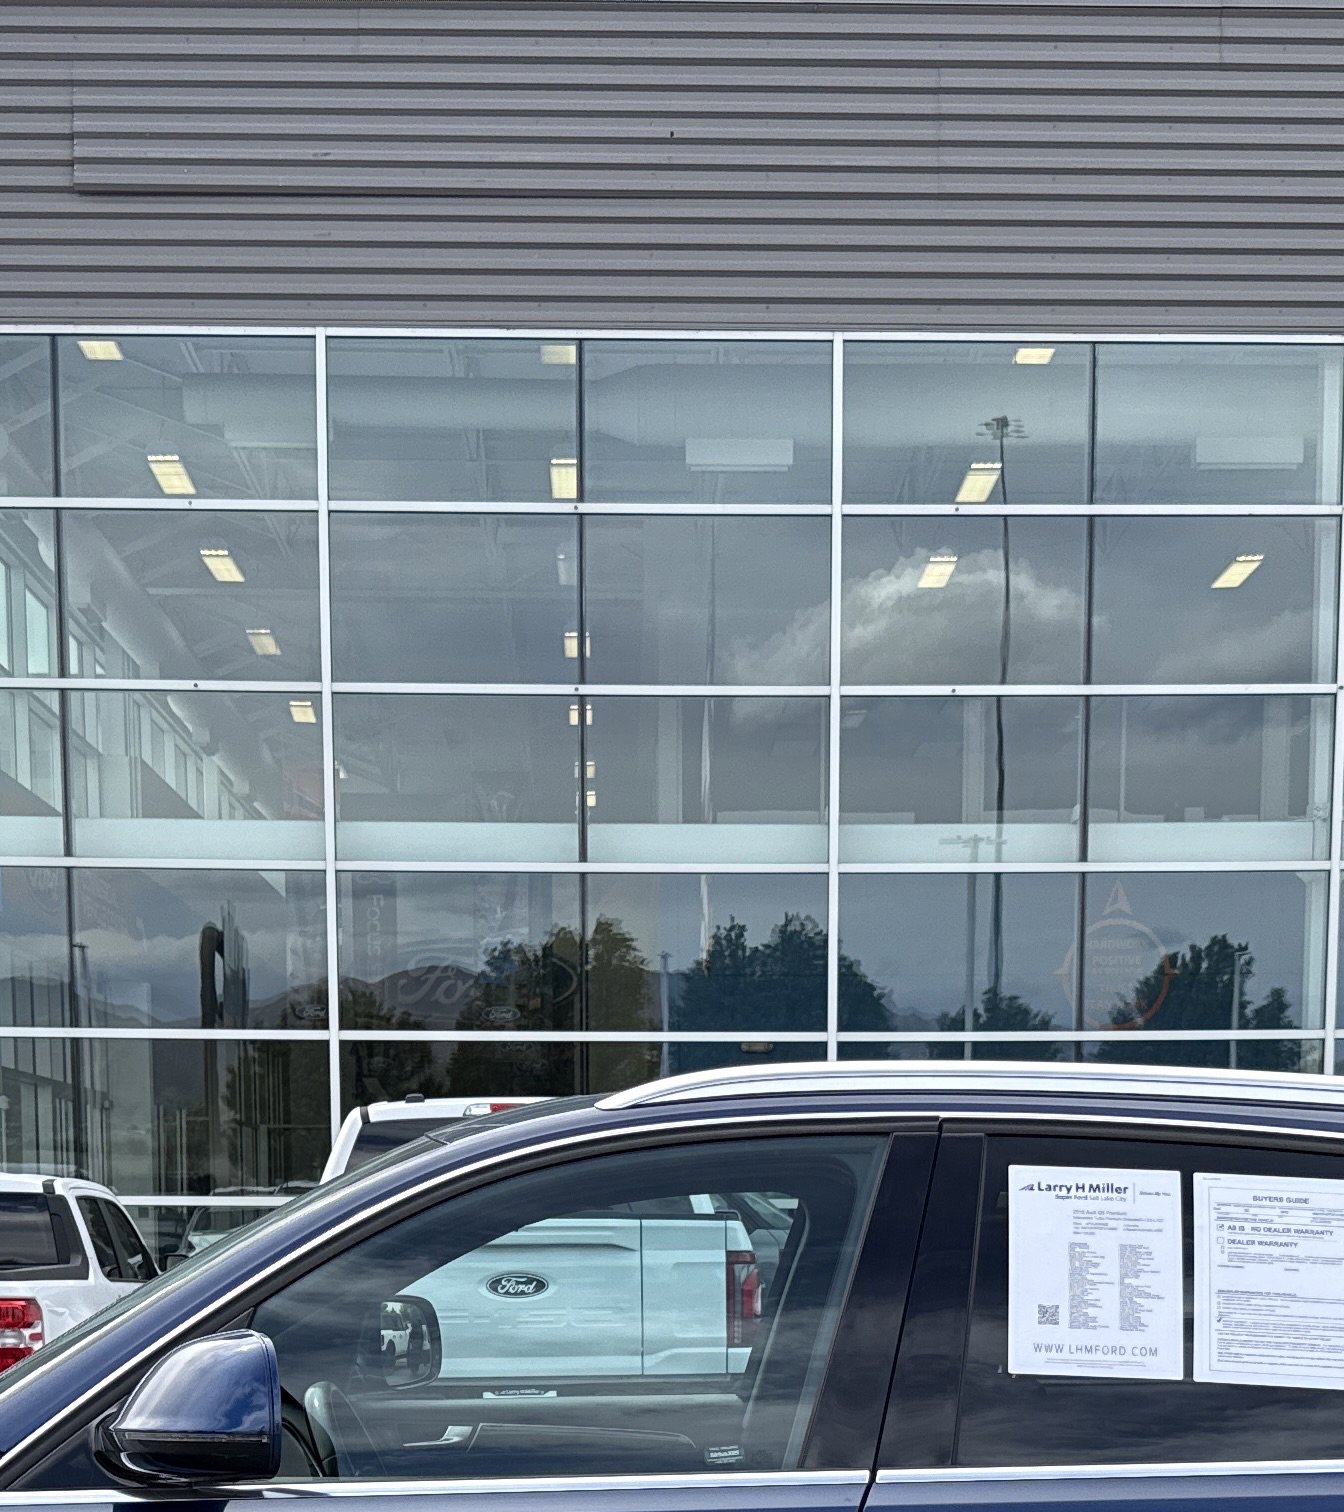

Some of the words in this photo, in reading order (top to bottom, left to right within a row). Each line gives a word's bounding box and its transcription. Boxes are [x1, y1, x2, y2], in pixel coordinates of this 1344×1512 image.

[1037, 1181, 1072, 1194] Larry
[1076, 1183, 1085, 1193] H
[1088, 1183, 1129, 1194] Miller
[1252, 1195, 1284, 1203] BUYERS
[1286, 1196, 1310, 1204] GUIDE
[1294, 1228, 1334, 1237] WARRANTY
[1227, 1238, 1255, 1246] DEALER
[1258, 1240, 1299, 1248] WARRANTY
[497, 1276, 537, 1295] Ford
